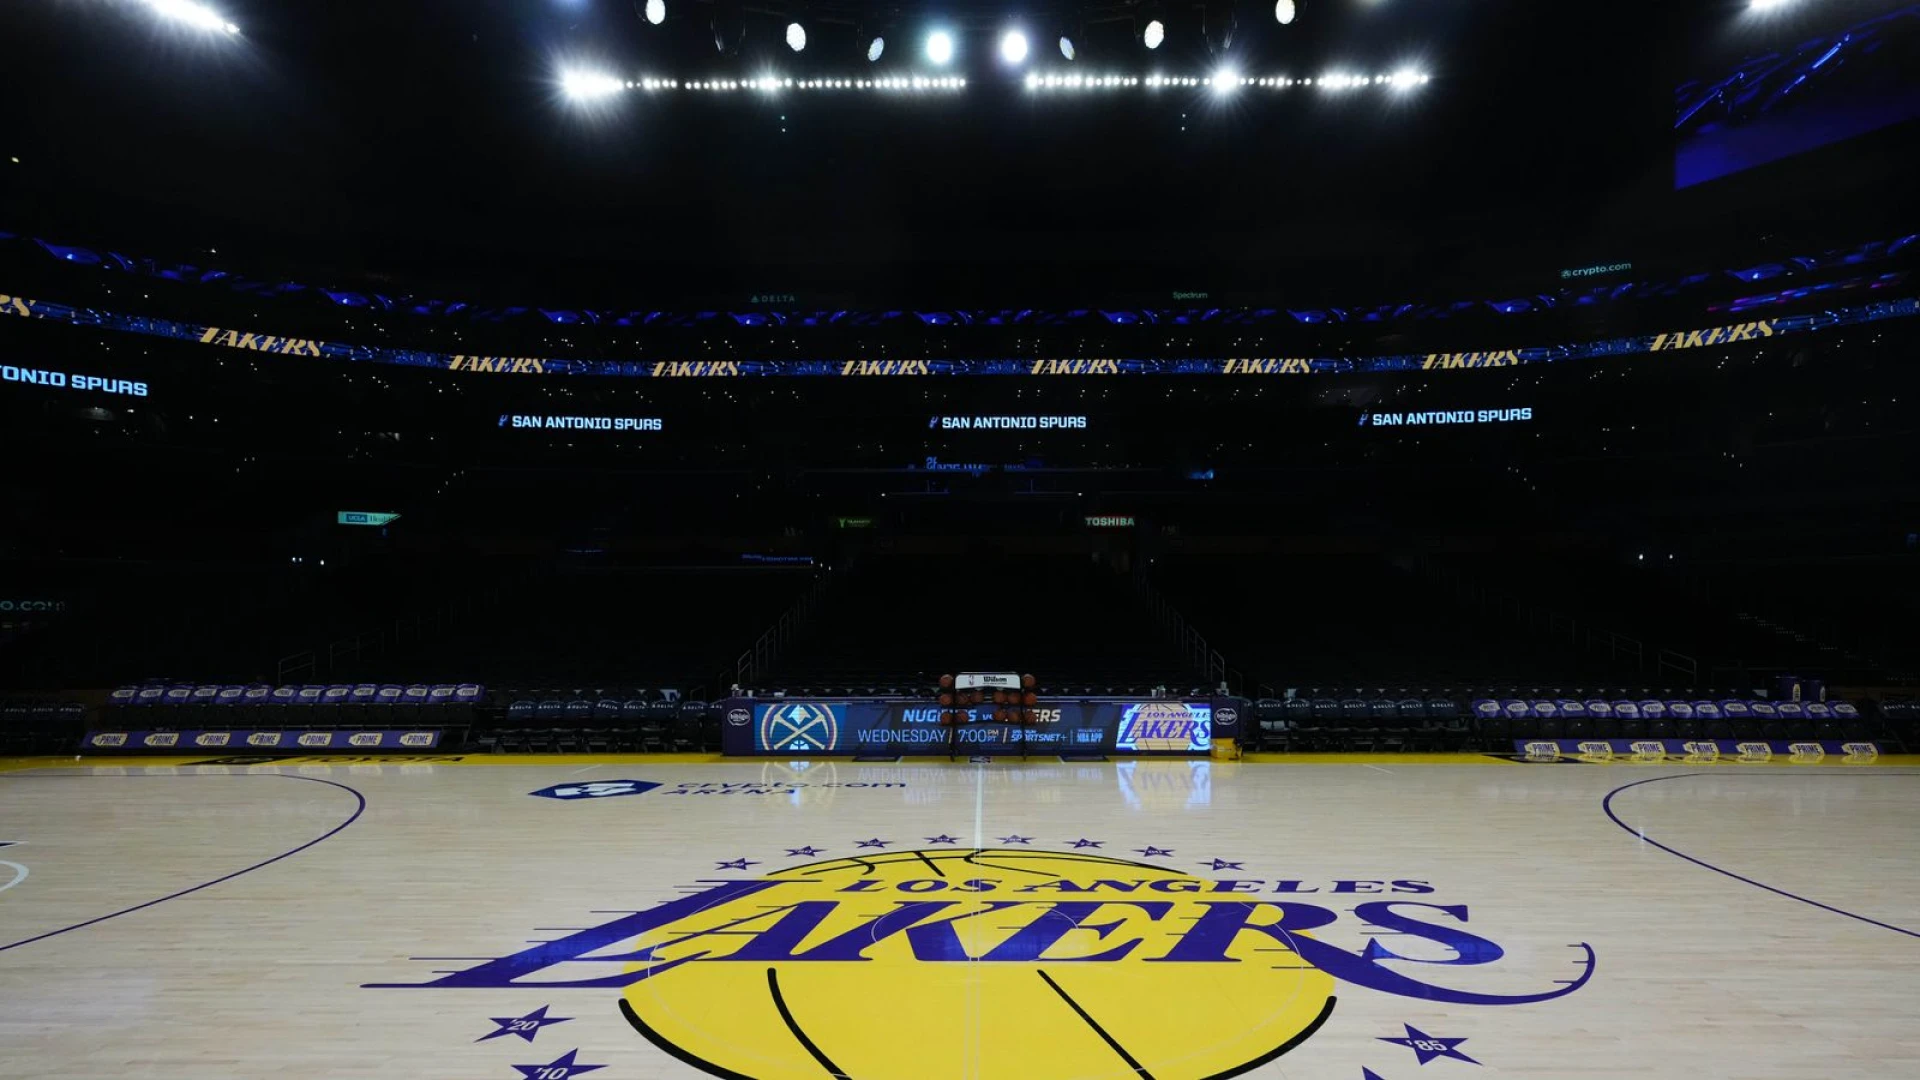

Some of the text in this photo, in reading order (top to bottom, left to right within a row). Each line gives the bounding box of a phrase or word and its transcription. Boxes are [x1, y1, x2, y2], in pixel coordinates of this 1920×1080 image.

[1572, 262, 1632, 278] crypto.com
[1172, 290, 1208, 300] Spectrum
[198, 326, 325, 356] LAKERS
[1650, 318, 1779, 352] LAKERS
[449, 354, 548, 374] LAKERS
[1222, 357, 1314, 374] LAKERS
[1422, 349, 1523, 371] LAKERS
[650, 360, 741, 377] LAKERS
[841, 359, 931, 376] LAKERS
[1031, 359, 1122, 376] LAKERS
[0, 365, 149, 397] ONIO SPURS
[511, 415, 663, 431] SAN ANTONIO SPURS
[941, 416, 1087, 429] SAN ANTONIO SPURS
[1372, 407, 1533, 426] SAN ANTONIO SPURS
[1084, 516, 1136, 527] TOSHIBA
[903, 708, 978, 722] NUGS
[857, 729, 946, 743] WEDNESDAY
[957, 729, 986, 743] 7:00
[1118, 712, 1210, 746] LAKERS
[101, 735, 122, 744] PRIME
[153, 735, 174, 744] PRIME
[204, 735, 225, 744] PRIME
[255, 735, 276, 744] PRIME
[305, 735, 327, 744] PRIME
[357, 735, 379, 744] PRIME
[406, 735, 428, 744] PRIME
[1011, 733, 1068, 742] SPRTSNET+
[836, 879, 1436, 893] LOS ANGELES
[360, 880, 1596, 1005] LAKERS
[506, 1018, 540, 1031] '20
[1406, 1040, 1448, 1051] '85
[533, 1067, 570, 1080] '10
